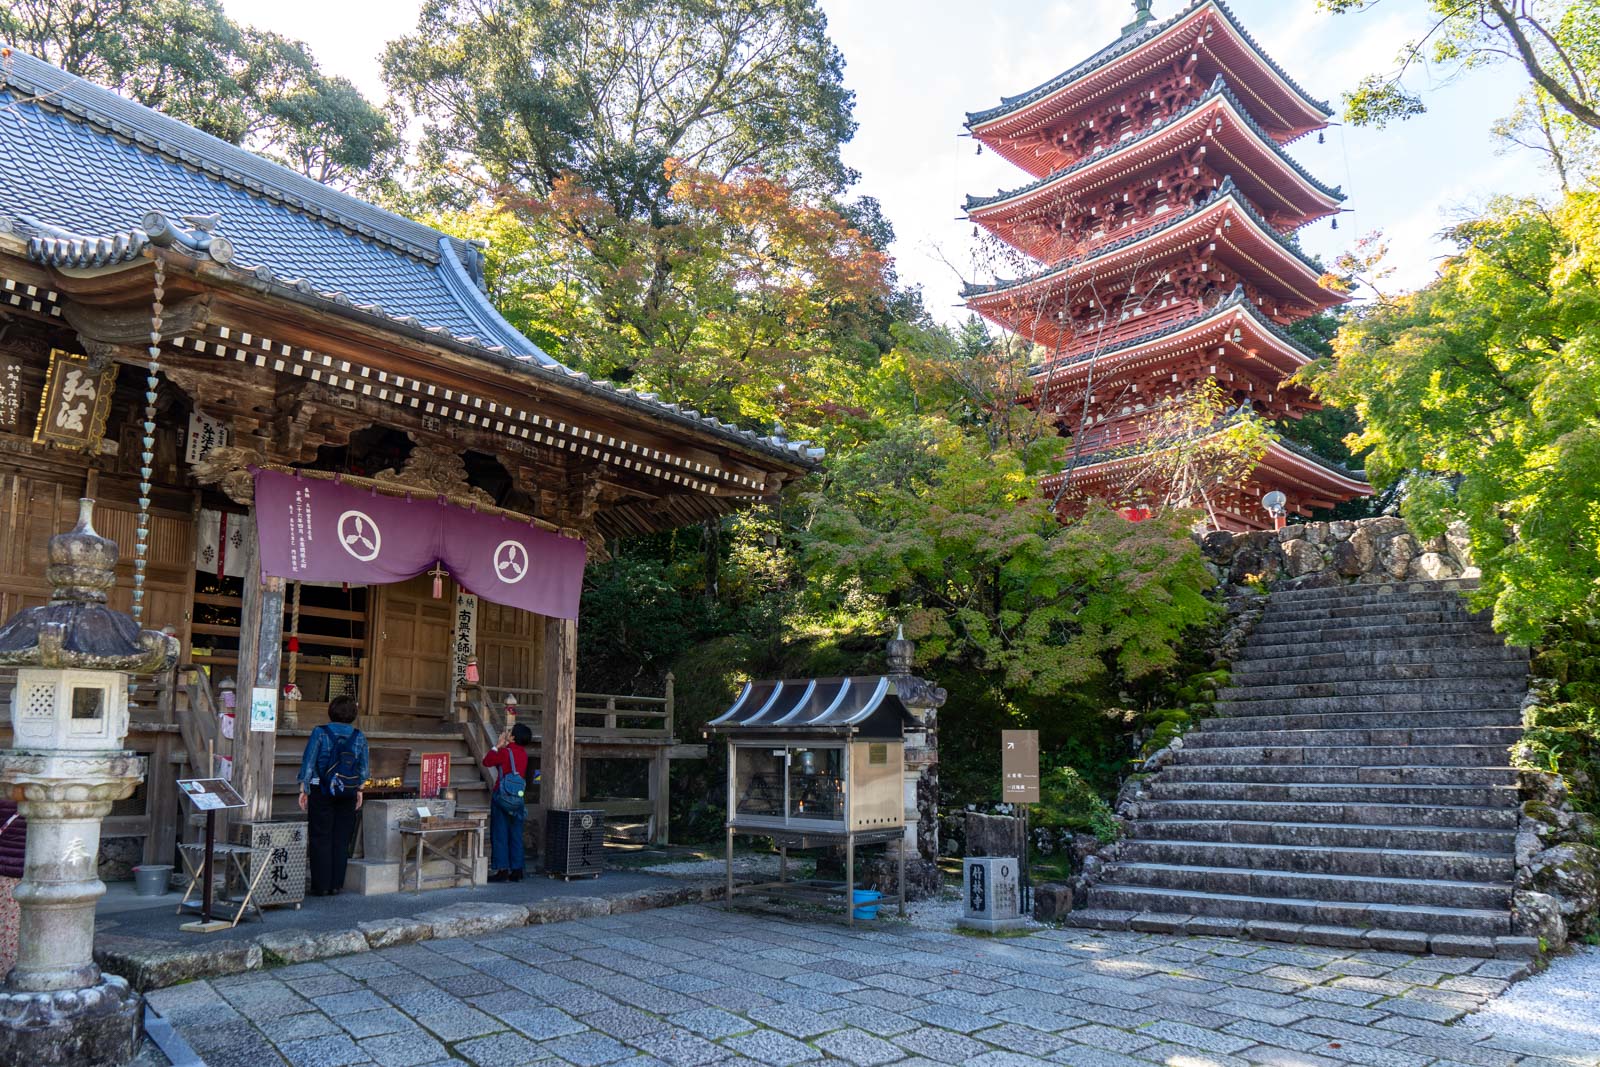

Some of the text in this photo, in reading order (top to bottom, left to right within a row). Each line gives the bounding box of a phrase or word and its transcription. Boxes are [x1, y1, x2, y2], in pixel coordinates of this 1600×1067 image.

[56, 369, 97, 433] 弘法
[61, 837, 90, 866] 奉
[271, 847, 289, 896] 納札入
[972, 865, 984, 910] 竹林寺
